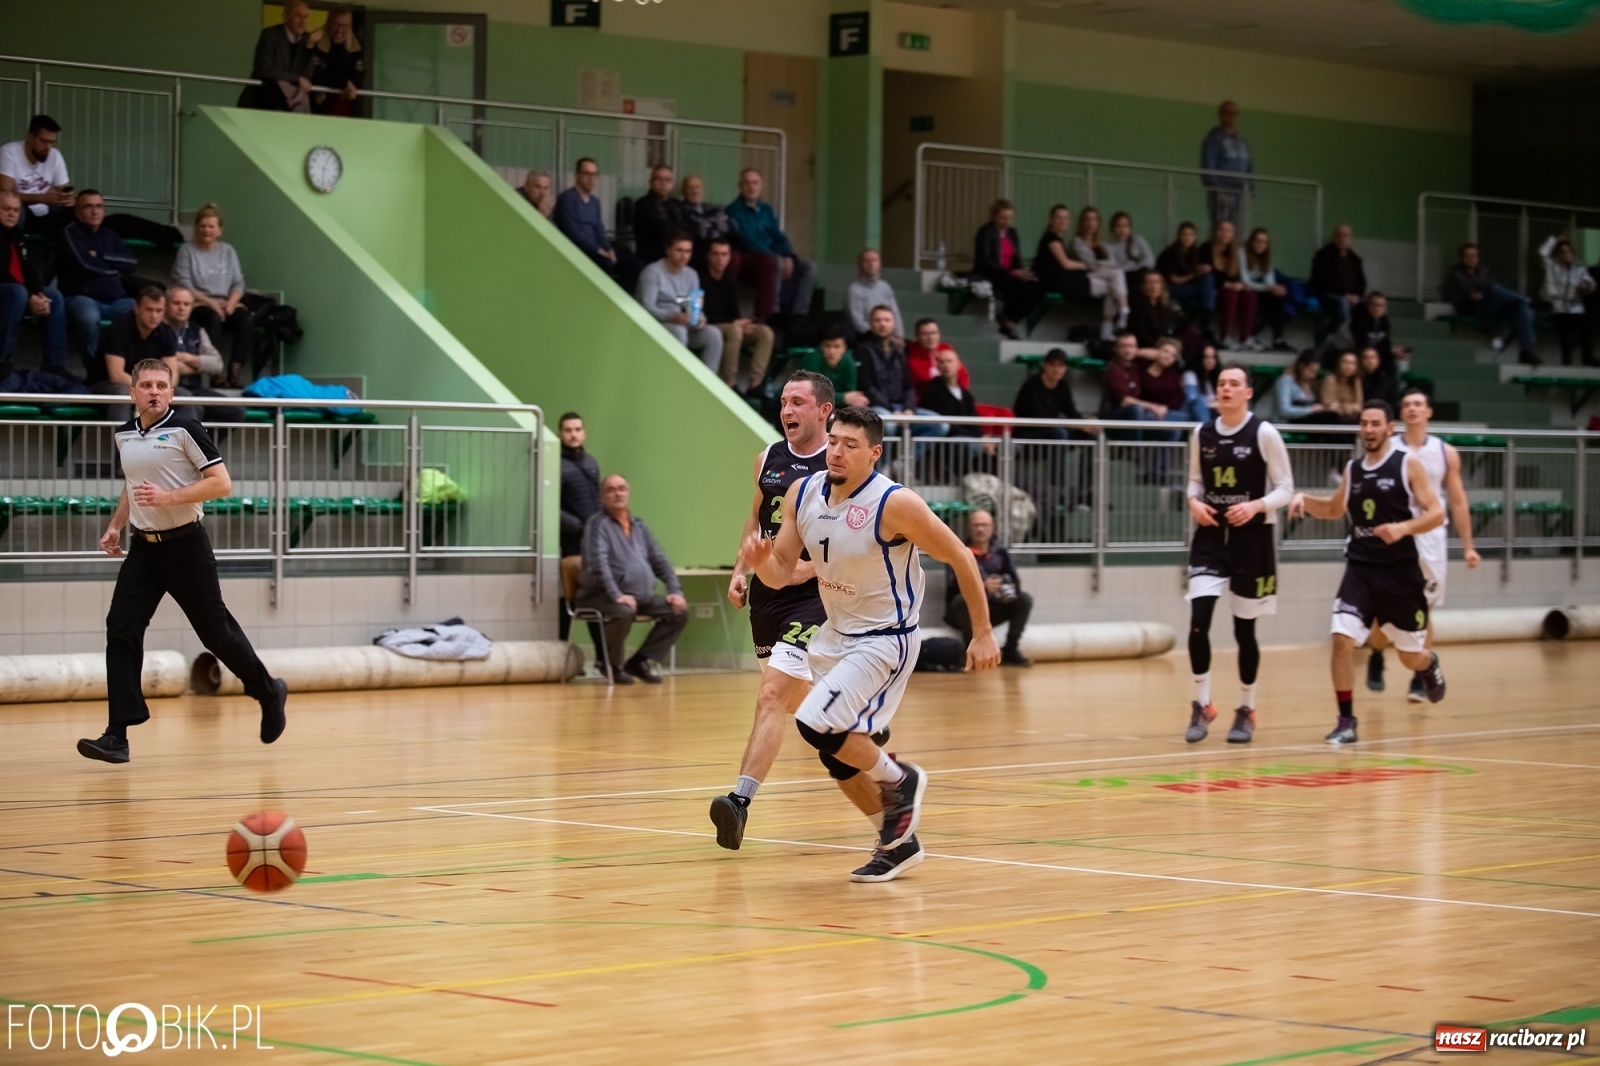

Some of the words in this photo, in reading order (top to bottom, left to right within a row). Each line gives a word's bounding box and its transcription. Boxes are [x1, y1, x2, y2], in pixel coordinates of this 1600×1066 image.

[564, 3, 588, 24] F
[840, 28, 860, 51] F
[1213, 466, 1237, 488] 14
[1362, 498, 1376, 520] 9
[819, 537, 830, 563] 1
[1256, 575, 1276, 597] 14
[1414, 610, 1425, 629] 9
[782, 621, 821, 651] 24
[823, 689, 841, 712] 1
